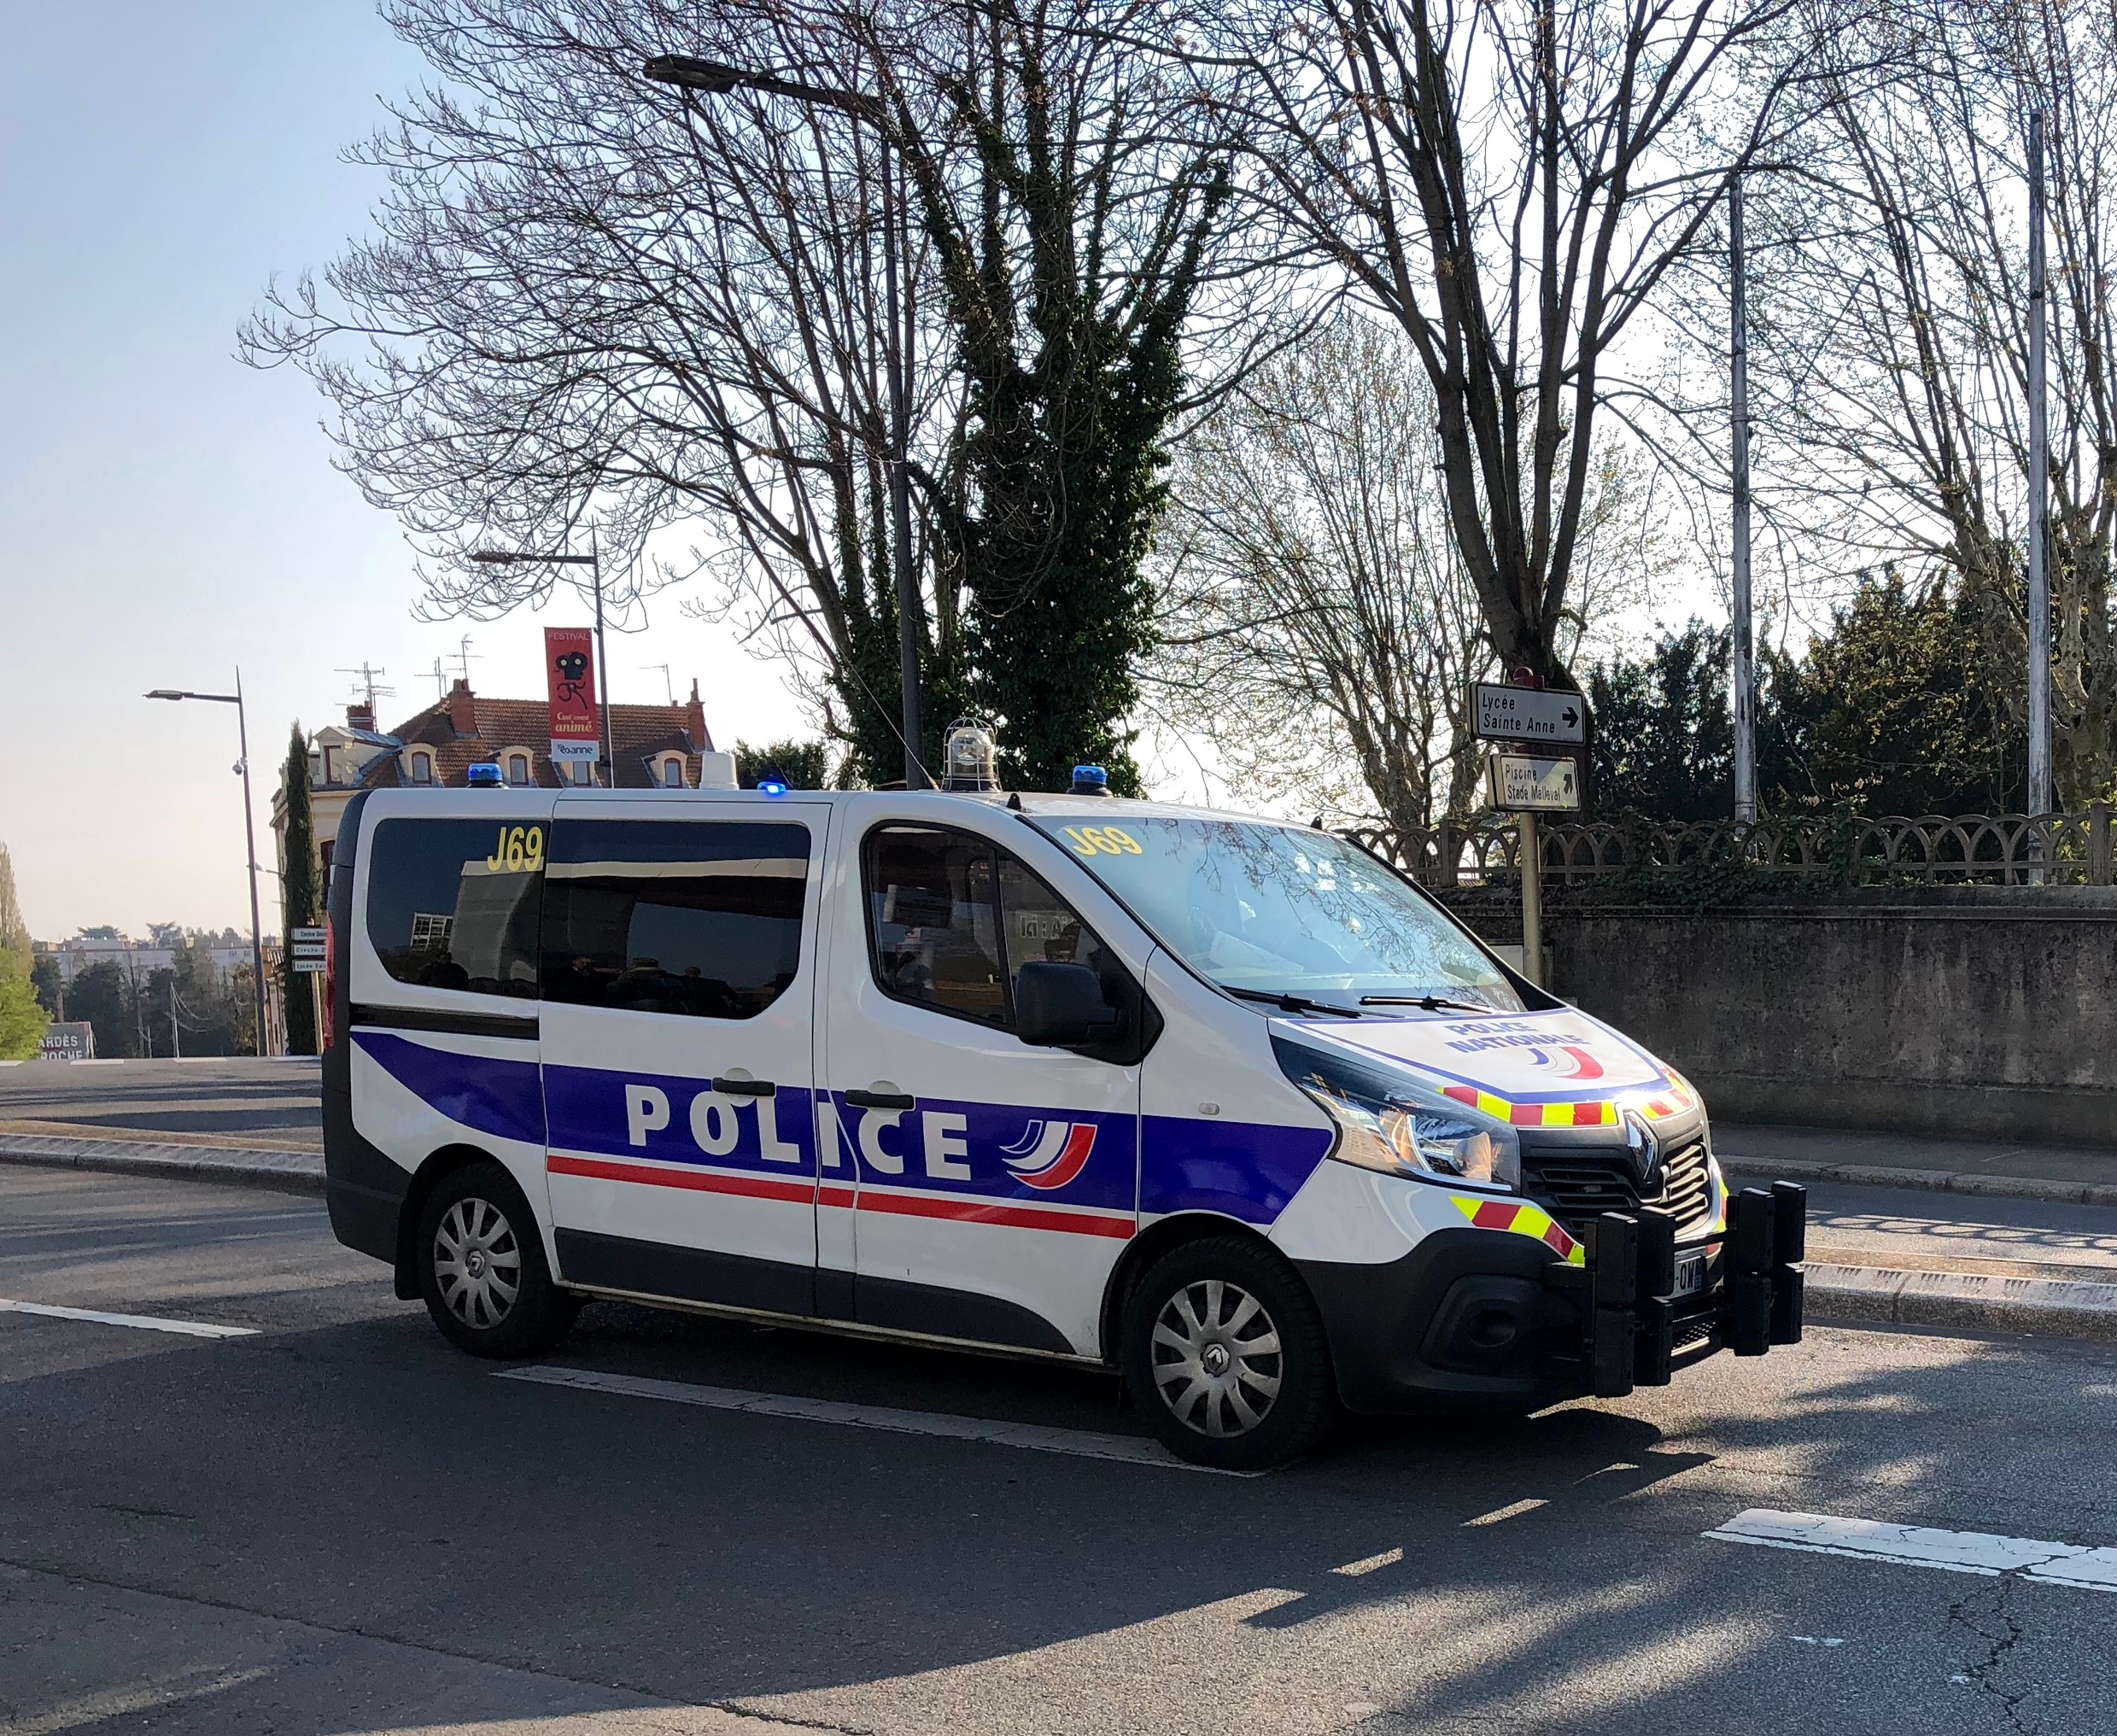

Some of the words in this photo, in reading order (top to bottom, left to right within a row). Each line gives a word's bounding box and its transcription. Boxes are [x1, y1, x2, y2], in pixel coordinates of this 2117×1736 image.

[548, 632, 589, 640] FESTIVAL
[1482, 693, 1515, 711] Lycée
[555, 721, 594, 733] animé
[1482, 713, 1521, 731] Sainte
[1526, 717, 1555, 734] Anne
[557, 744, 594, 755] Roanne
[1506, 763, 1537, 781] Piscine
[1507, 784, 1529, 800] Stade
[487, 826, 543, 872] J69
[1064, 826, 1143, 856] J69
[1443, 1021, 1538, 1036] POLICE
[1444, 1033, 1592, 1053] NATIONALE
[624, 1084, 972, 1182] POLICE
